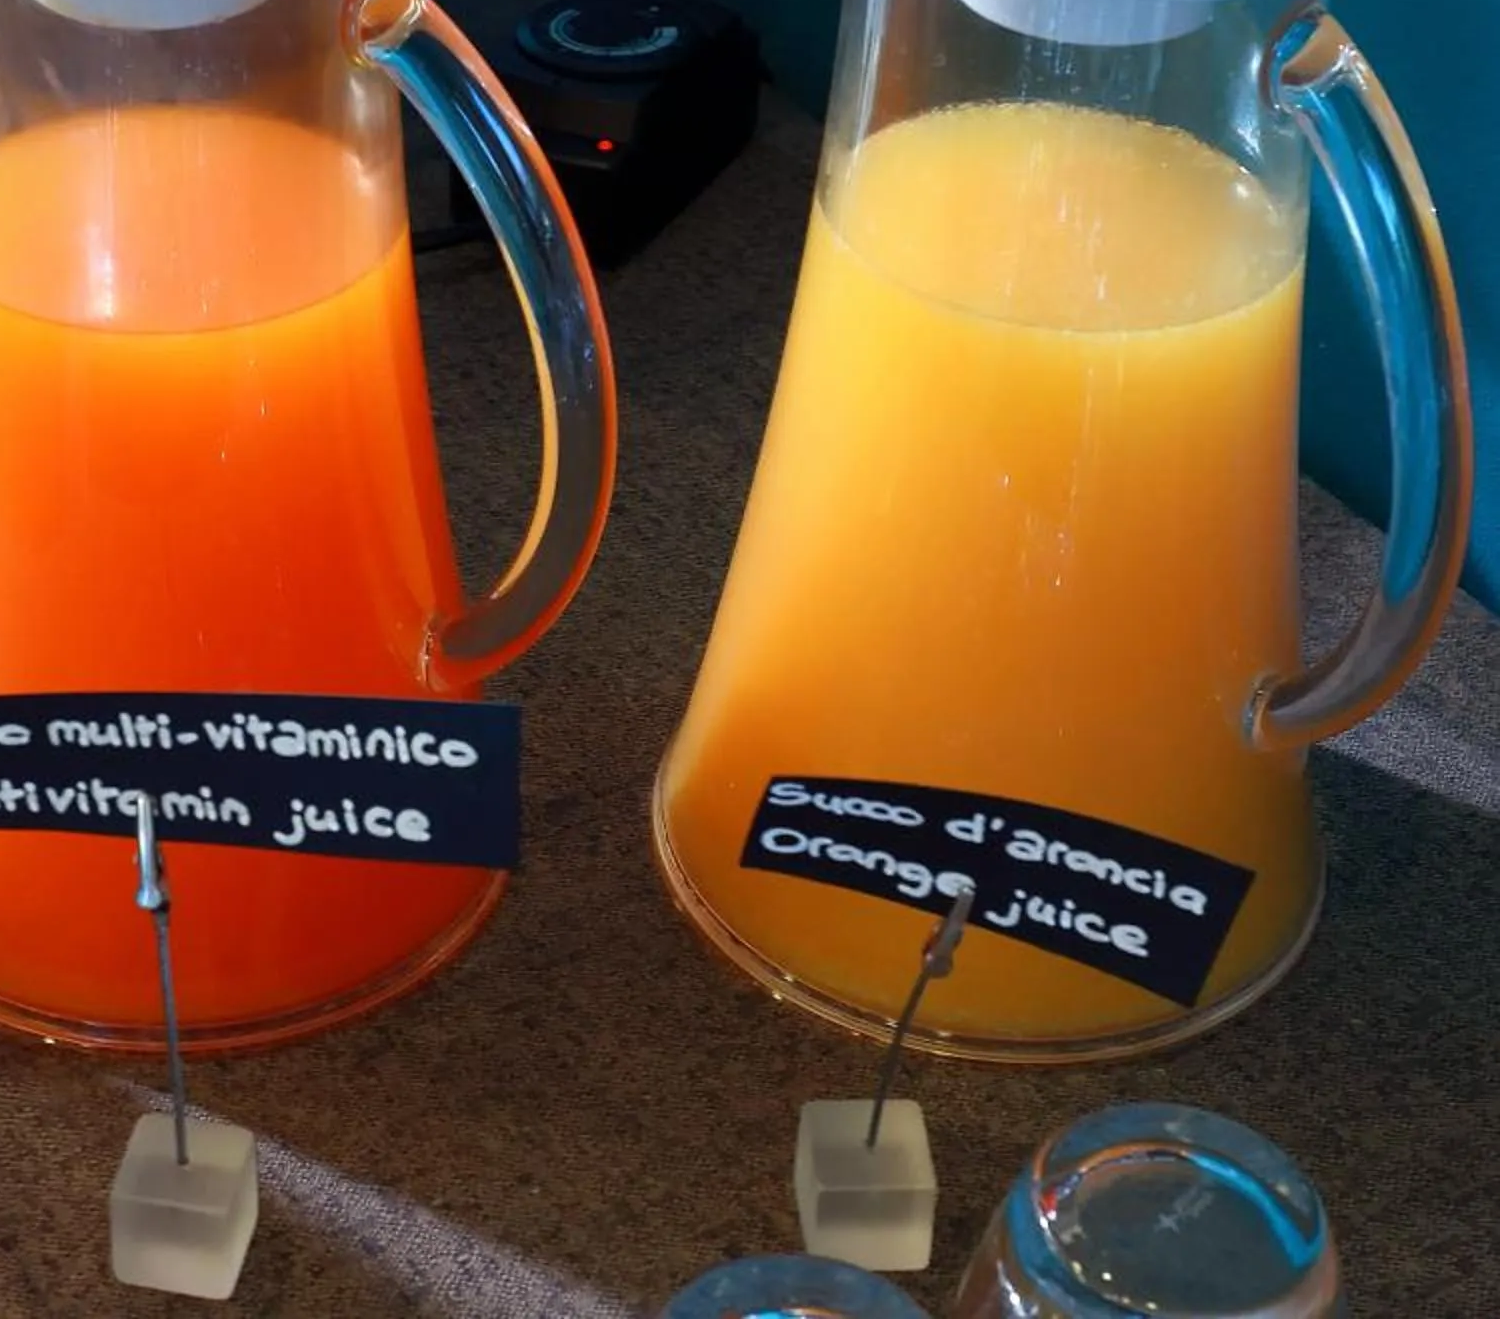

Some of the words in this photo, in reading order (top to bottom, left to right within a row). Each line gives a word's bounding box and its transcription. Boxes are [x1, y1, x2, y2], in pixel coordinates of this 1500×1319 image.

[272, 798, 431, 846] juice
[767, 783, 926, 827] Succo
[944, 813, 1207, 917] d'arancia
[760, 826, 977, 899] Orange
[985, 889, 1150, 958] juice
